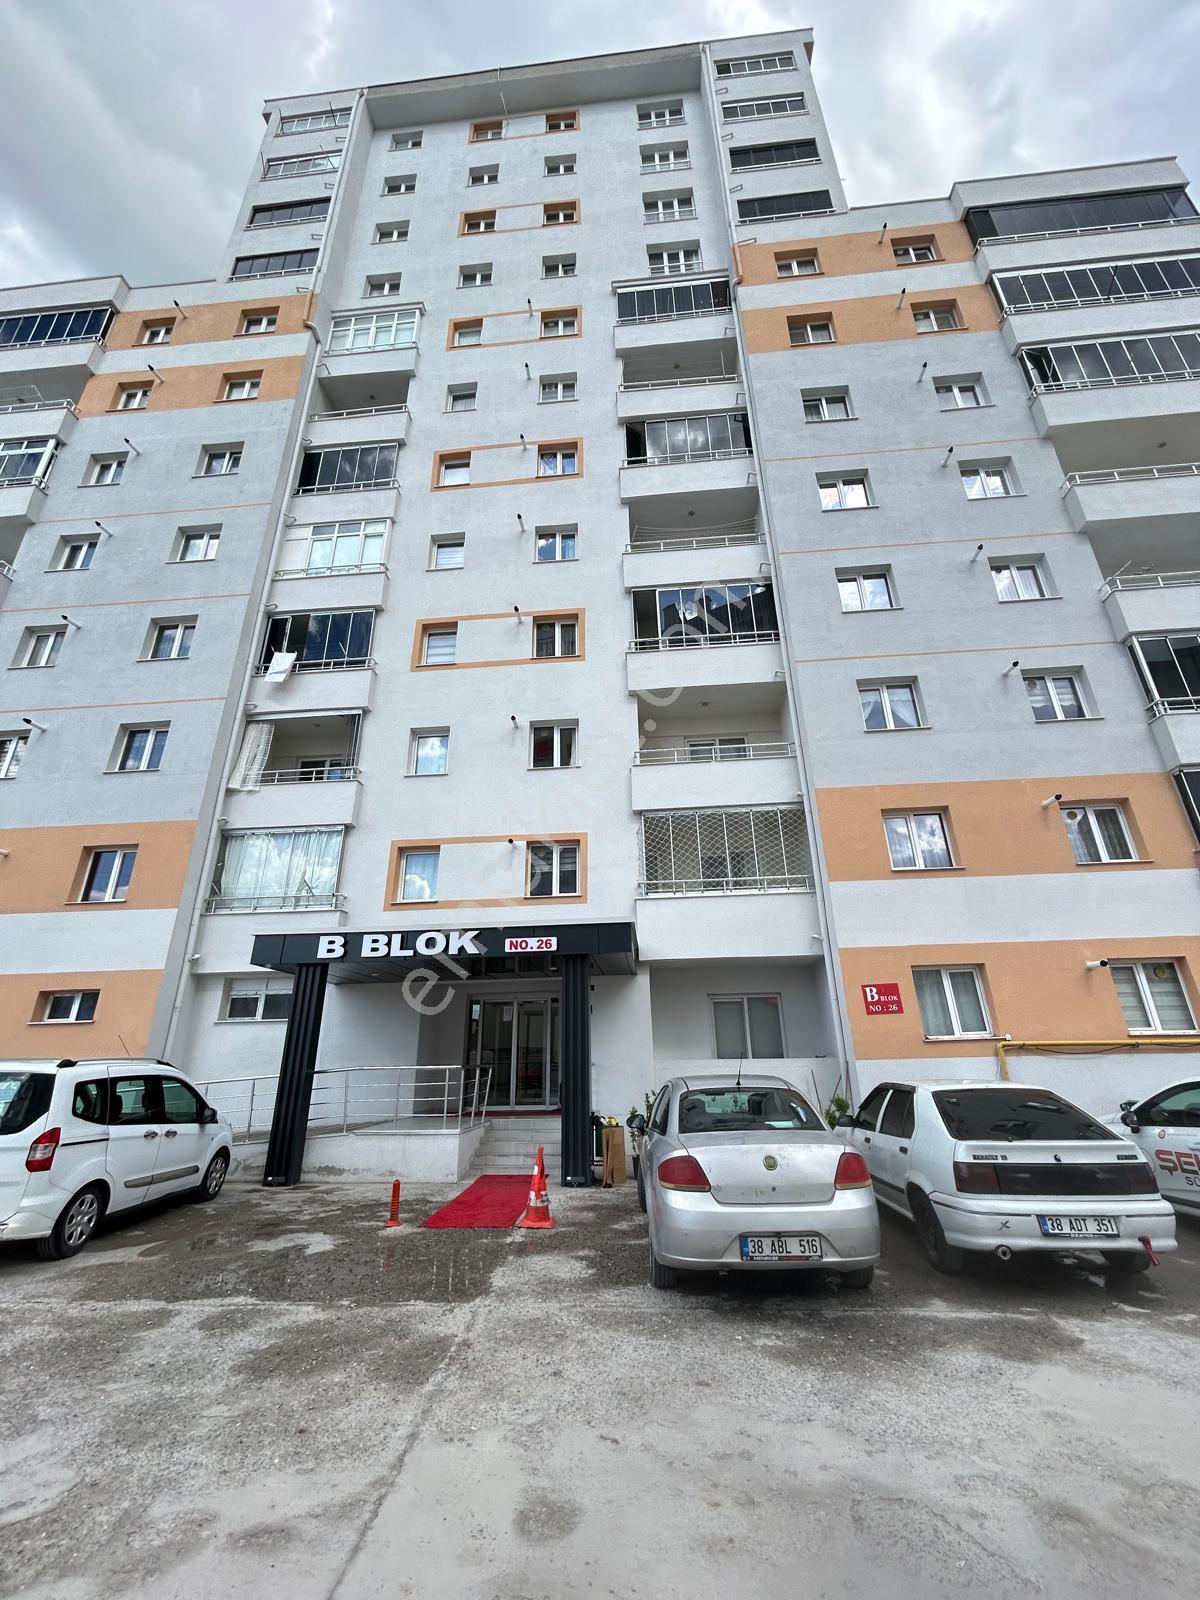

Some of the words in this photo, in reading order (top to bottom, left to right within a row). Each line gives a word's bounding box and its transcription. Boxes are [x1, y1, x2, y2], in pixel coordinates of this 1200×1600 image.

[317, 935, 345, 959] B
[361, 930, 481, 958] BLOK
[864, 986, 879, 1002] B
[1048, 1217, 1064, 1232] 38
[1069, 1218, 1089, 1232] ADT
[1094, 1218, 1115, 1232] 351
[749, 1239, 764, 1254] 38
[770, 1239, 792, 1254] ABL
[799, 1239, 818, 1254] 516
